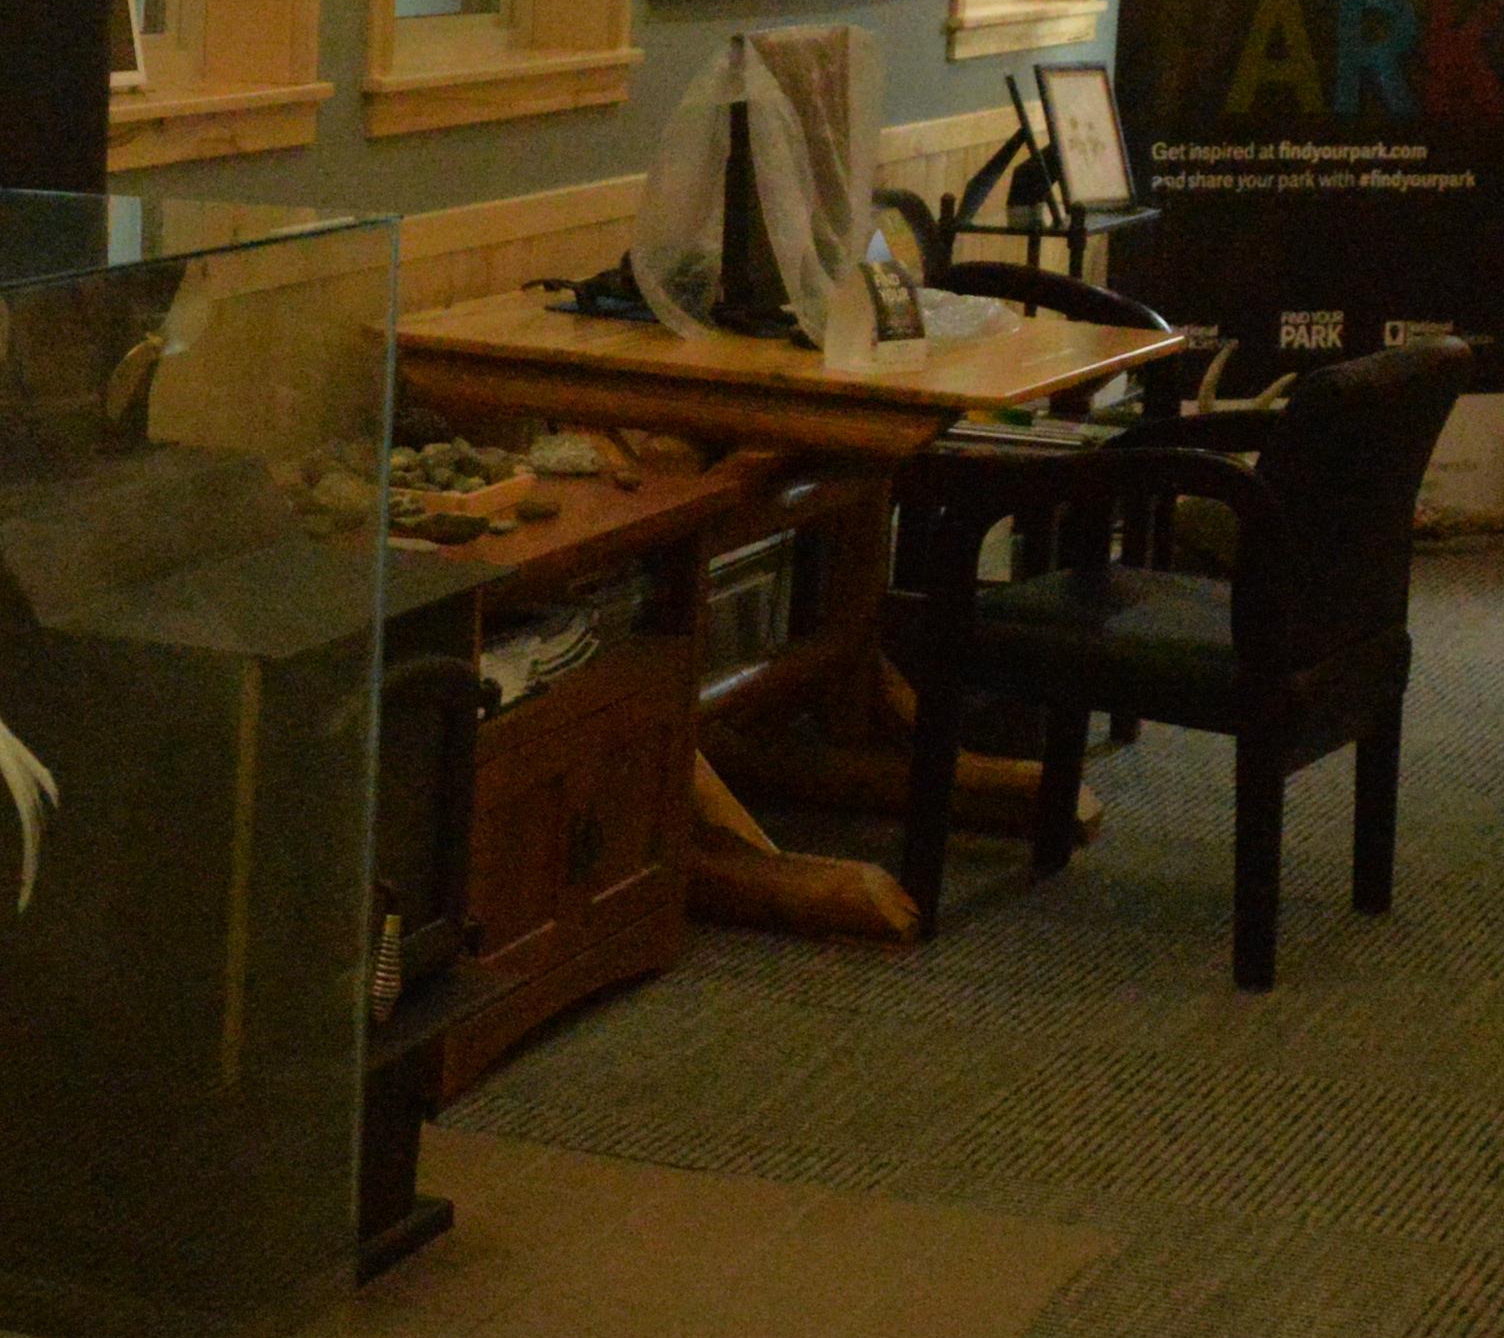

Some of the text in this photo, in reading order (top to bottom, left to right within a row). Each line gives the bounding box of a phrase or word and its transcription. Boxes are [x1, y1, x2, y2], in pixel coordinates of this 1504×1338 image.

[1151, 142, 1428, 165] Get inspired at findyourpark.com
[1188, 170, 1233, 189] share
[1235, 174, 1273, 193] your
[1277, 170, 1315, 192] park
[1318, 170, 1356, 189] with
[1359, 170, 1476, 193] #findyourpark
[1280, 310, 1345, 324] FIND YOUR
[1280, 324, 1344, 349] PARK
